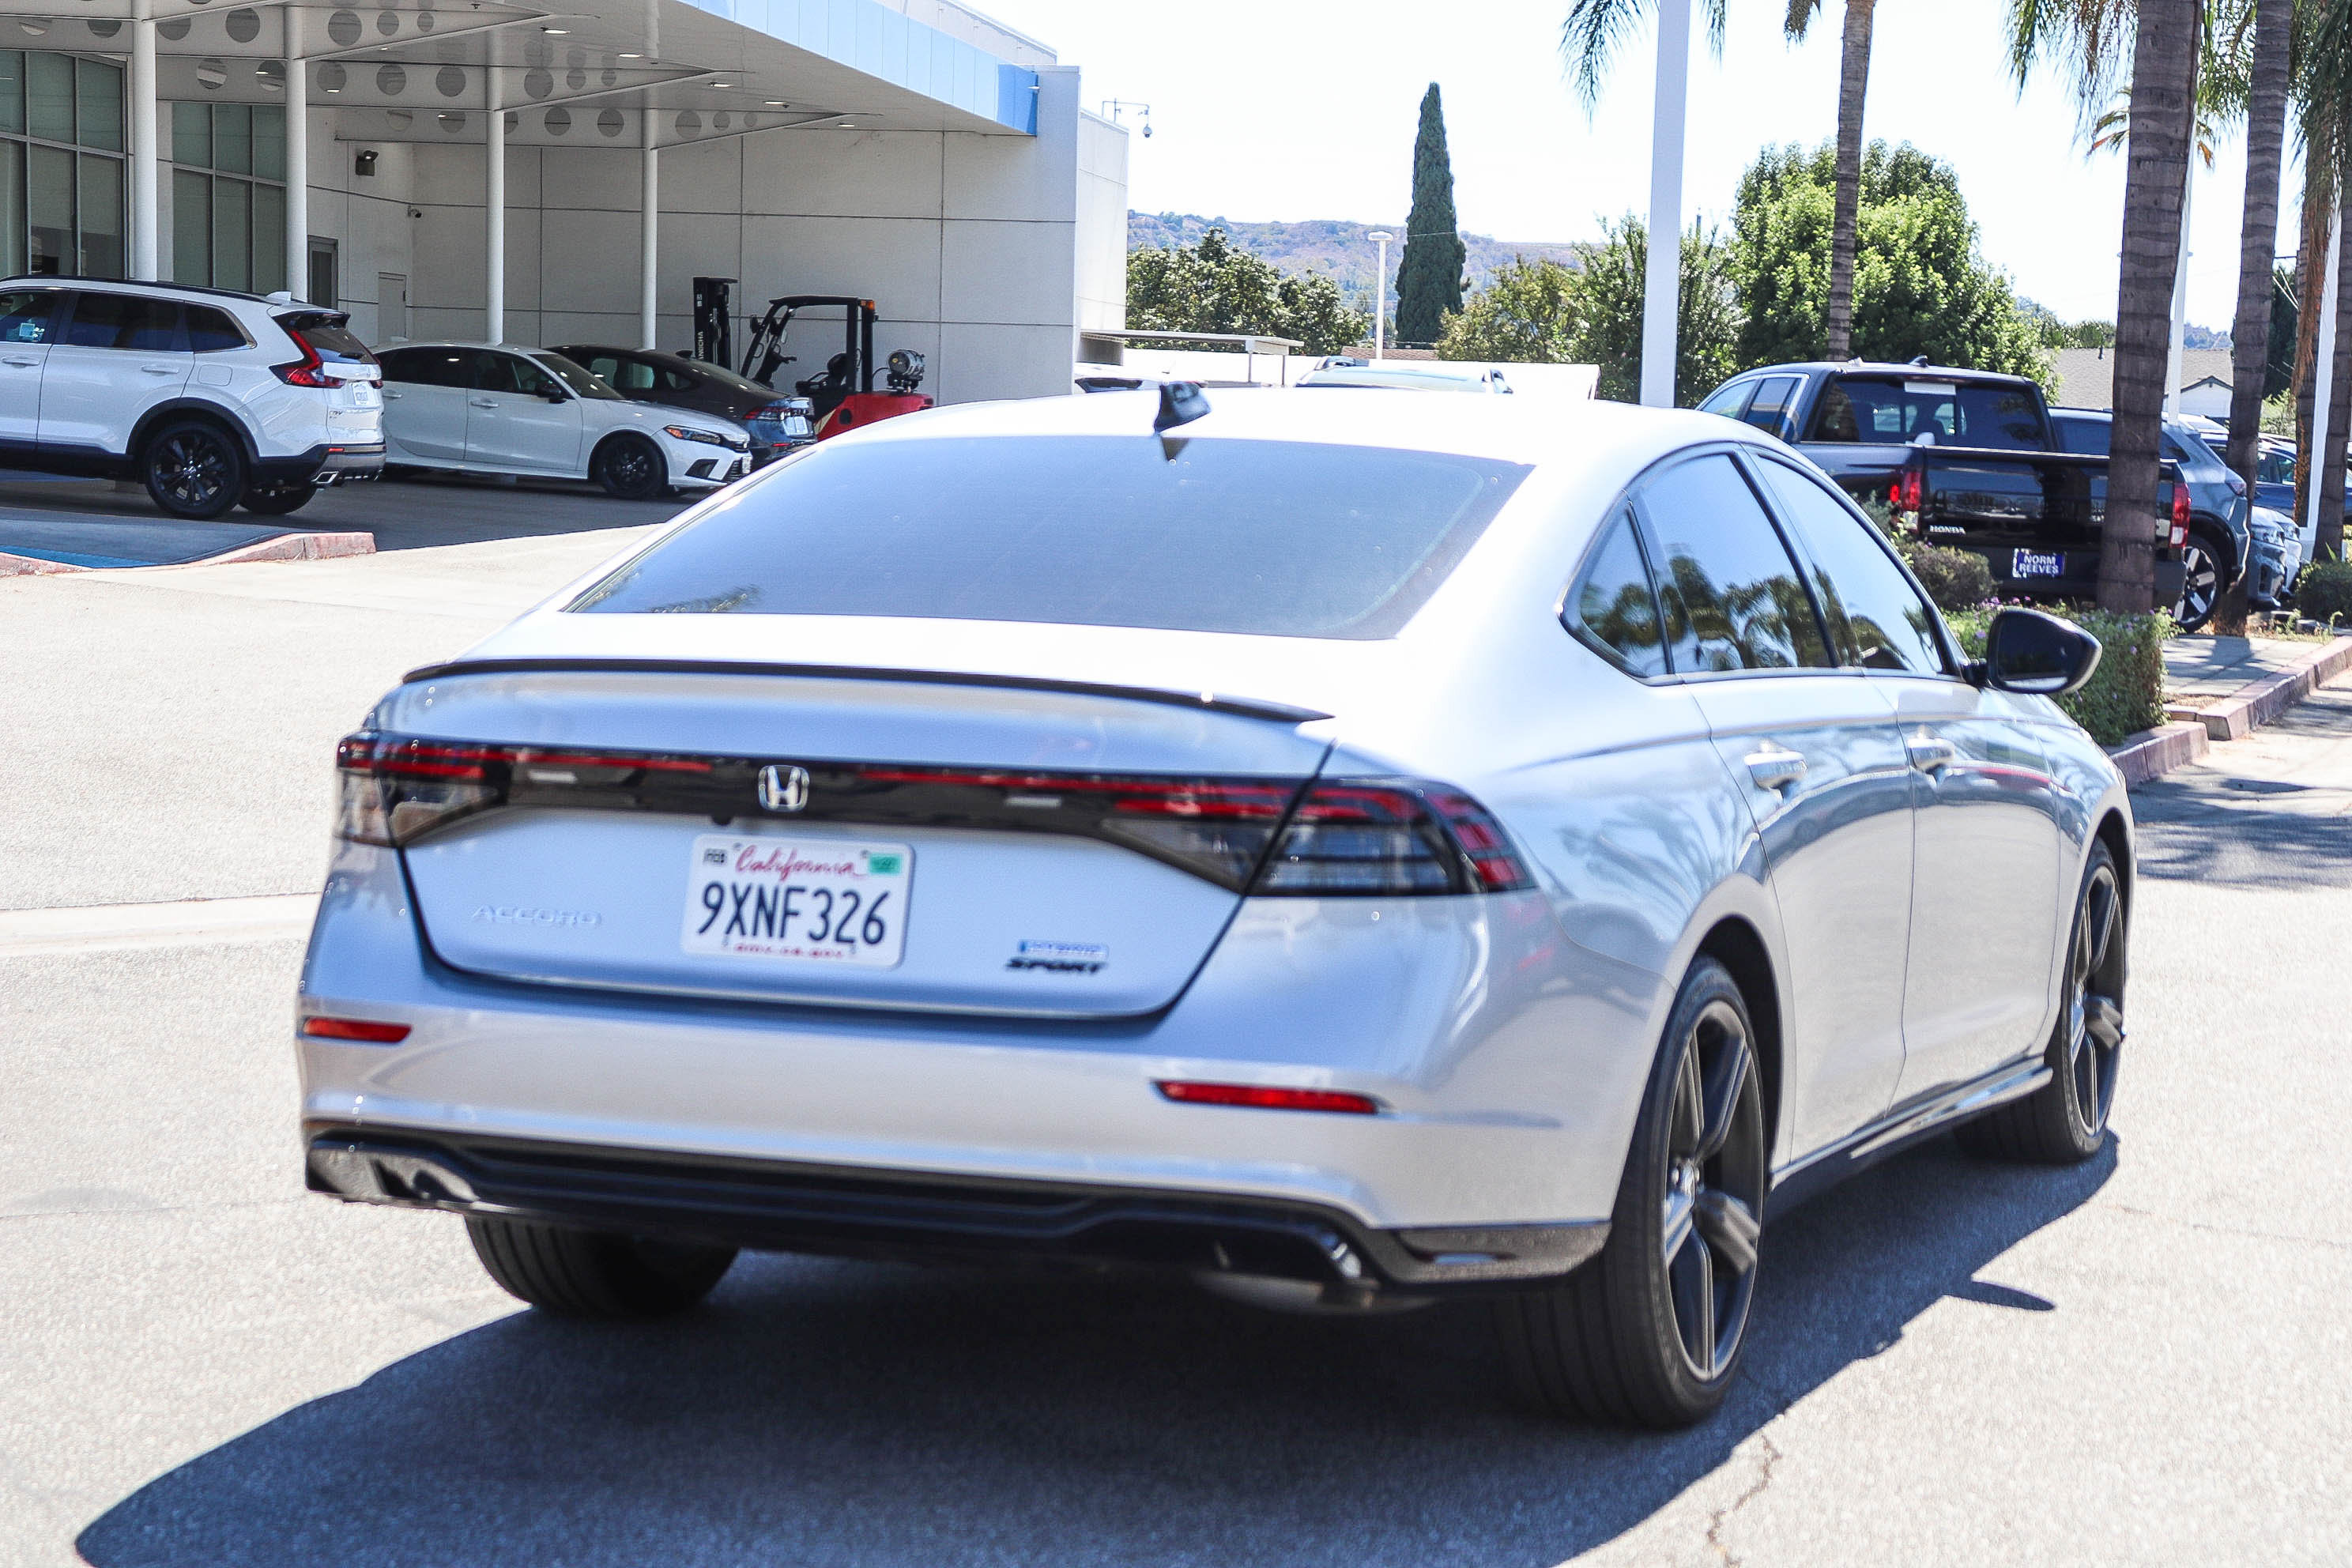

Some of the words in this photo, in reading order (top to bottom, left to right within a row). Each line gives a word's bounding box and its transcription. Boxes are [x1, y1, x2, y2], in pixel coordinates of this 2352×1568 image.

[1929, 525, 1966, 534] HONDA
[2019, 563, 2060, 575] REEVES
[2023, 555, 2056, 565] NORM
[735, 844, 867, 882] California
[471, 905, 603, 928] ACCORD
[696, 880, 891, 946] 9XNF326
[1005, 957, 1109, 975] SPORT
